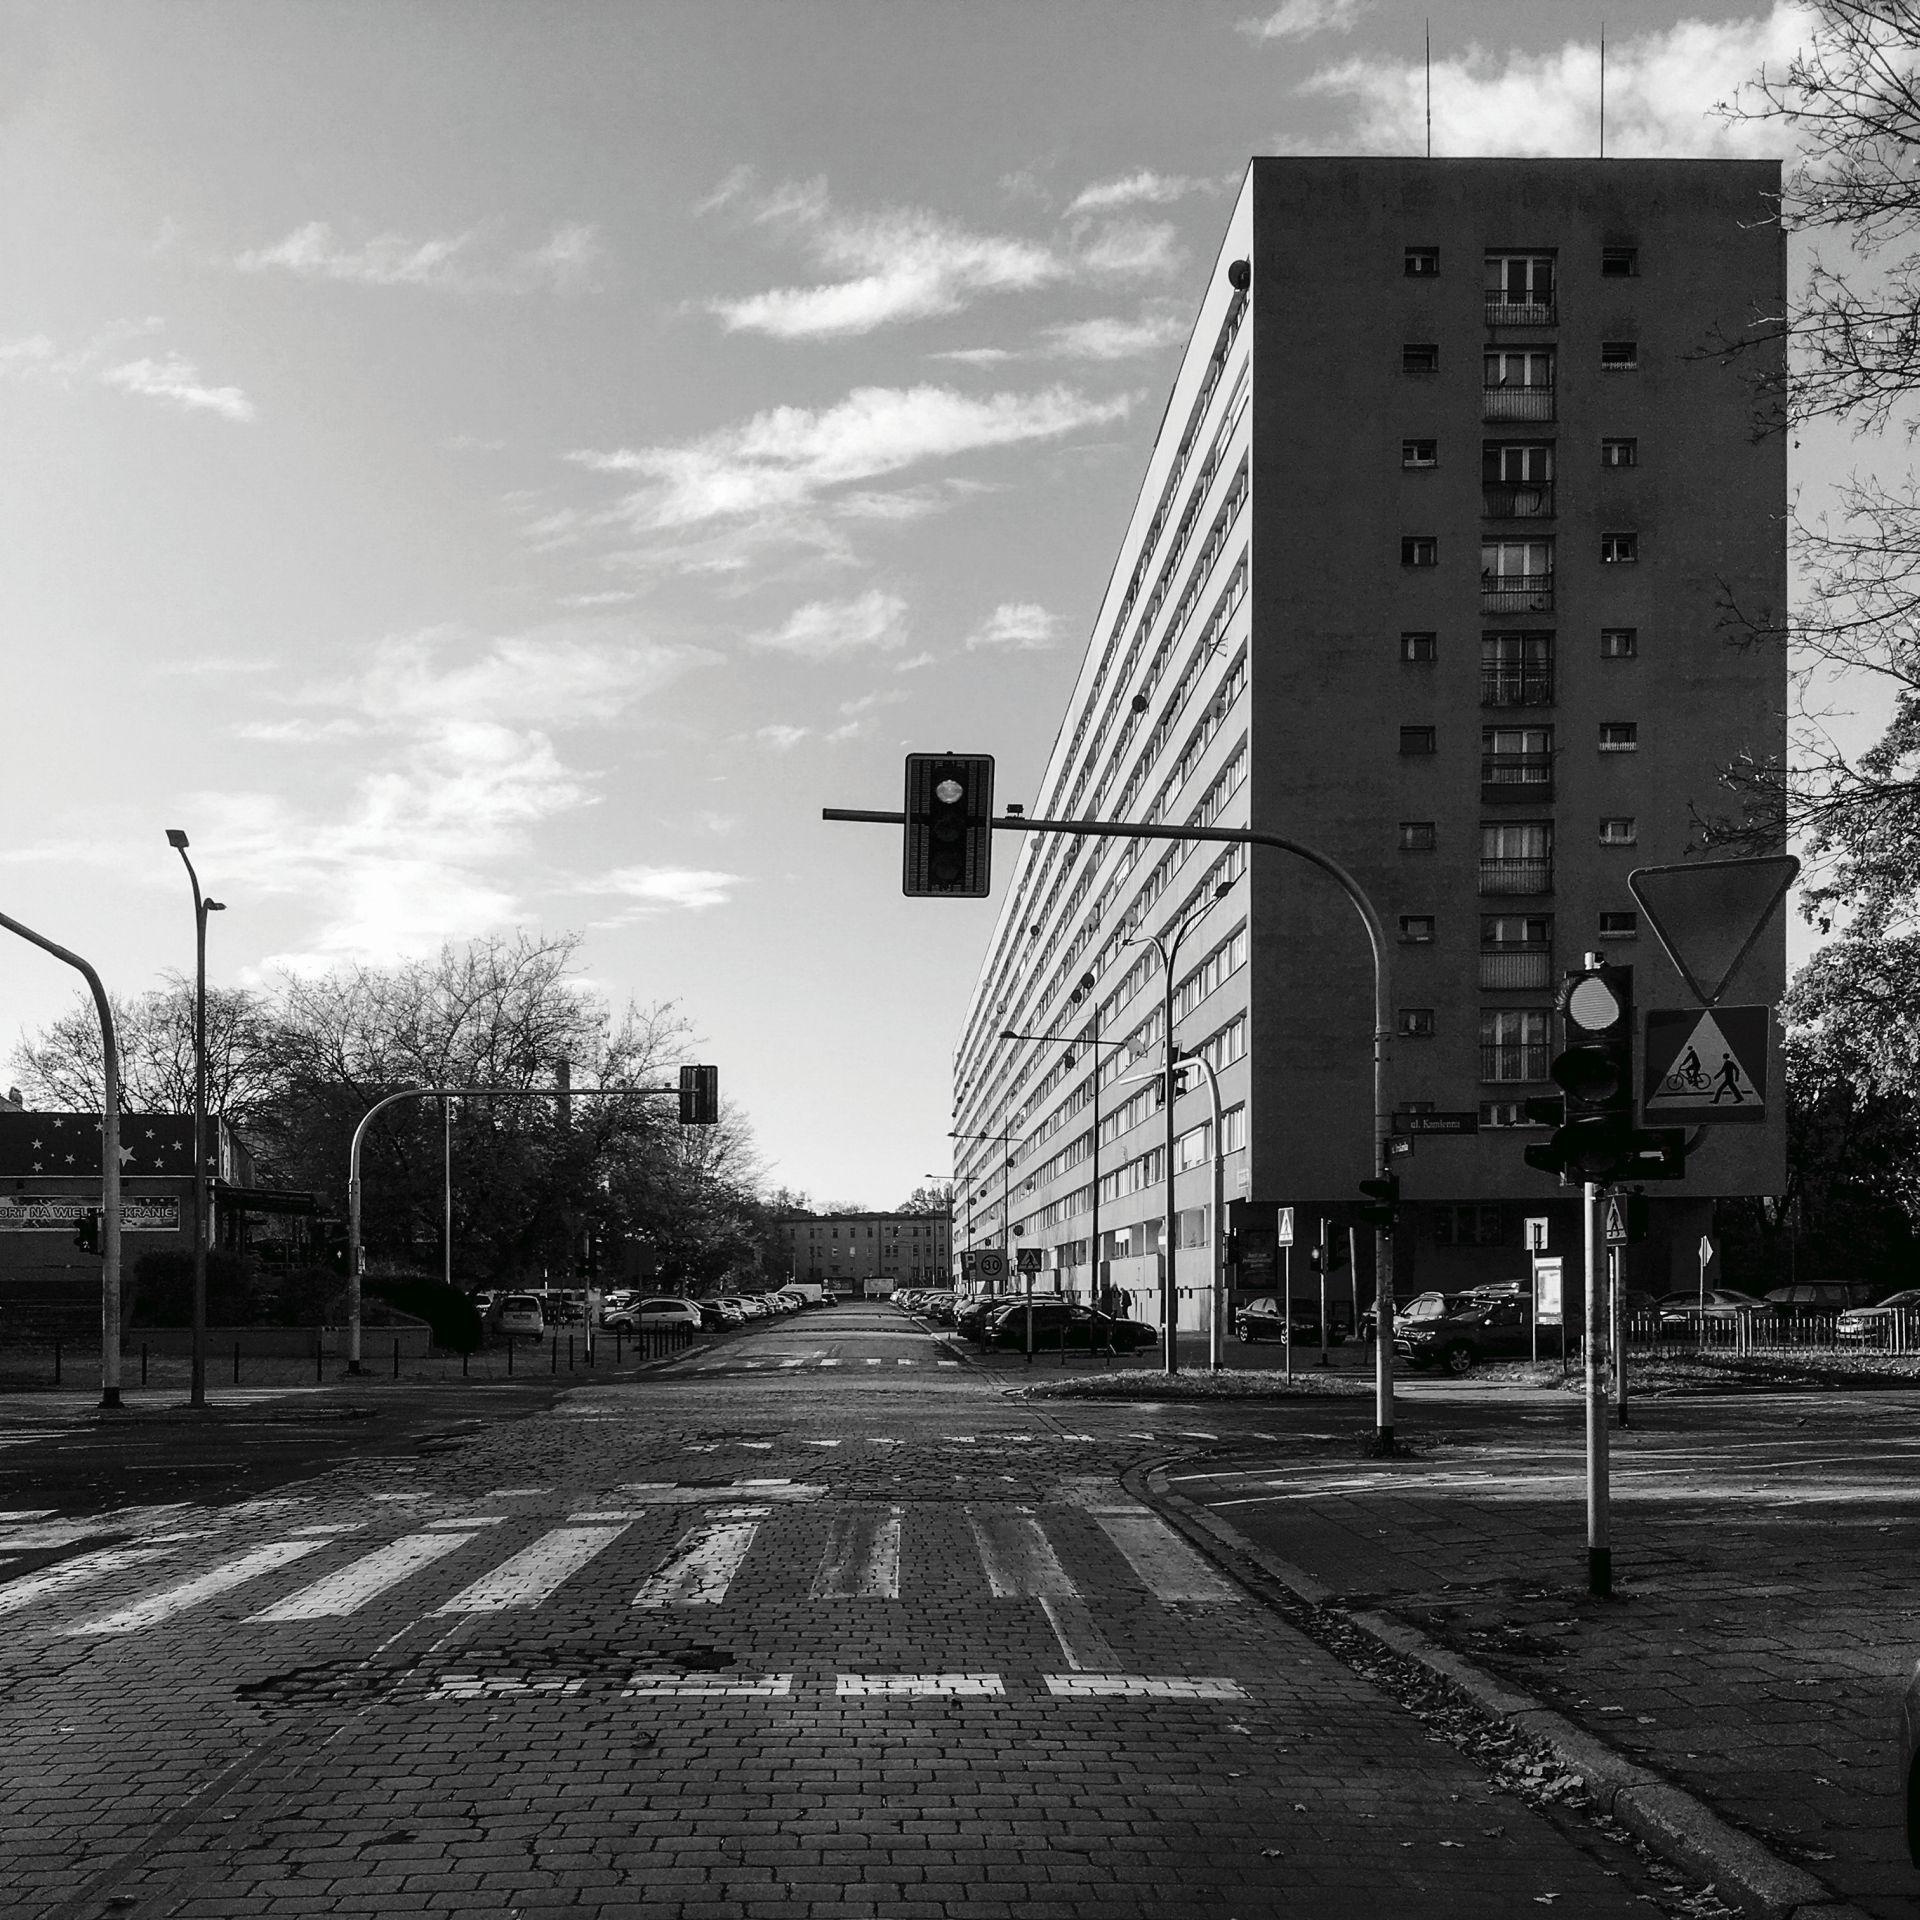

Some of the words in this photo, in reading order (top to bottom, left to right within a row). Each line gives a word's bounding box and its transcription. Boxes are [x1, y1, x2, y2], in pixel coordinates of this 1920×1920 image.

[30, 1207, 50, 1218] NA
[53, 1207, 103, 1218] WIEL
[119, 1207, 174, 1218] EKRANIE
[984, 1259, 999, 1271] 30
